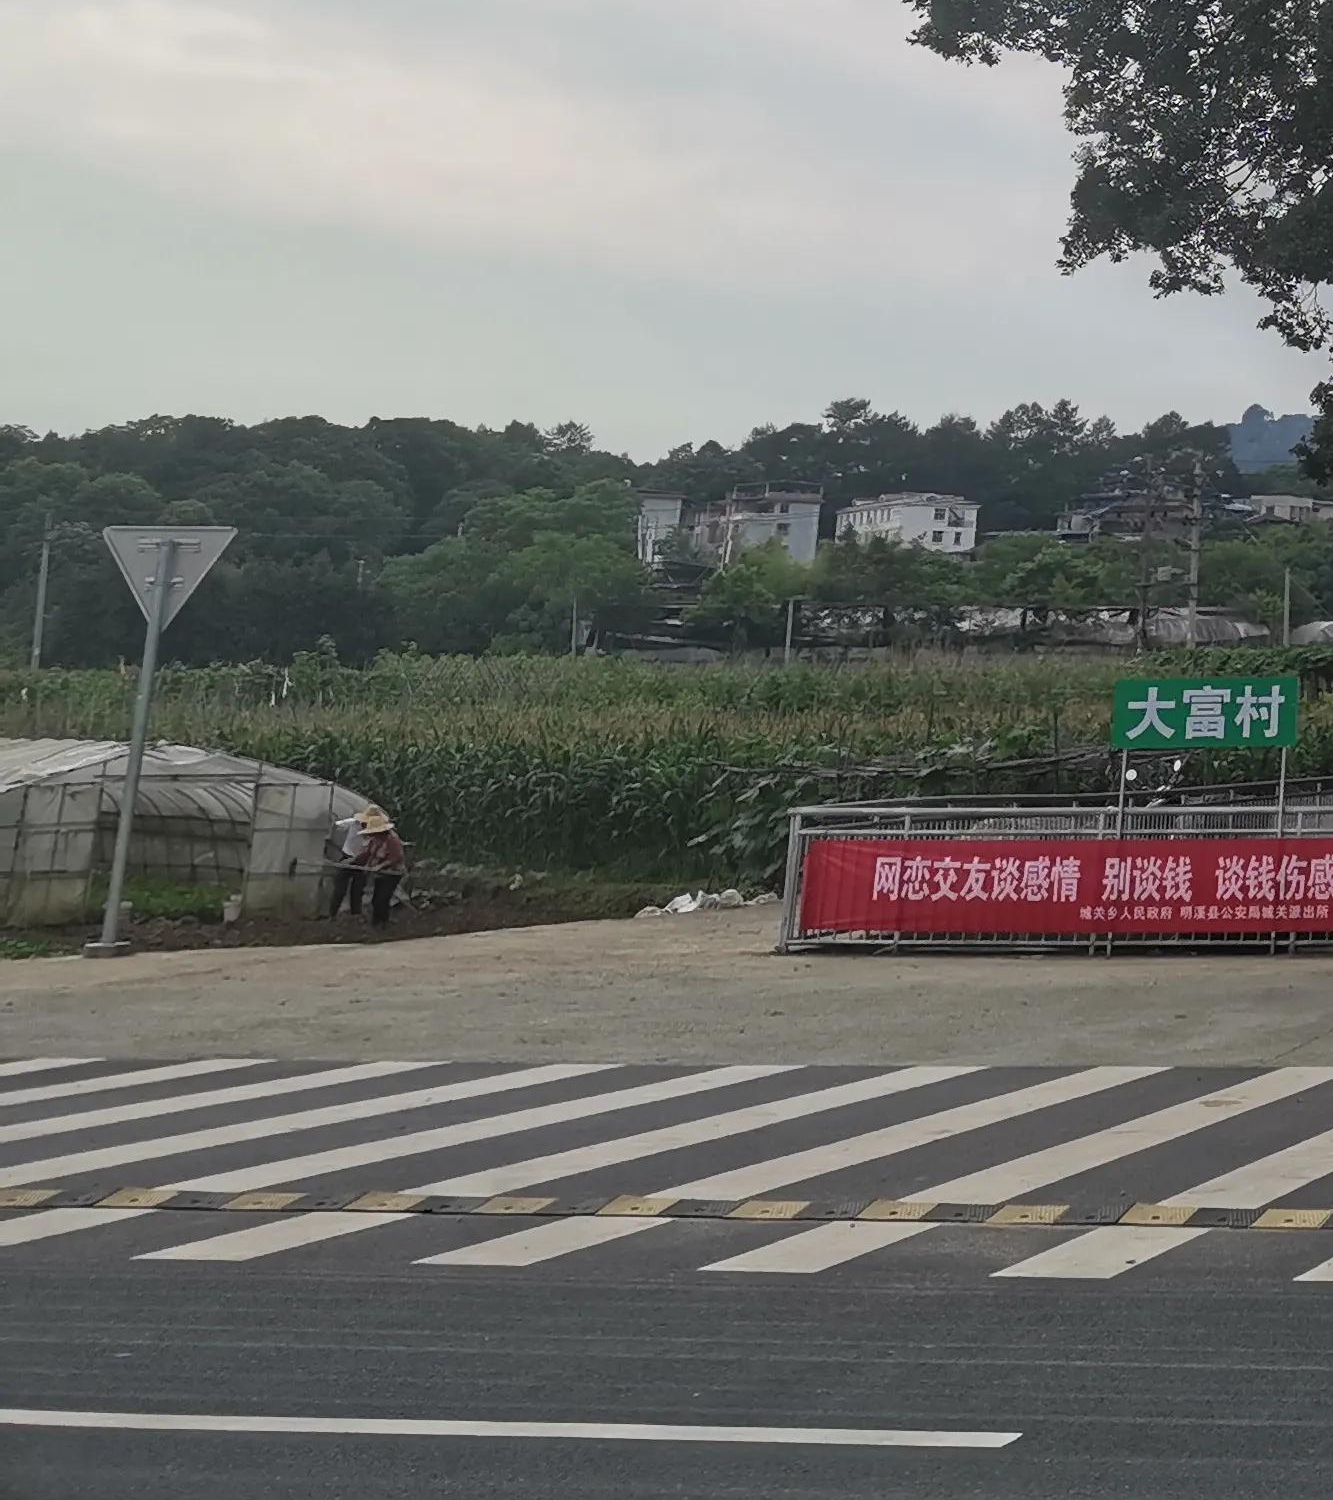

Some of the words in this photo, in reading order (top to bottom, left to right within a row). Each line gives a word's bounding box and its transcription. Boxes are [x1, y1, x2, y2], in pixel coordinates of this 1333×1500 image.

[1125, 685, 1286, 740] 大富村
[872, 856, 1081, 902] 网恋交友谈感情
[1101, 856, 1193, 902] 别谈钱
[1079, 905, 1173, 920] 城关乡人民政府
